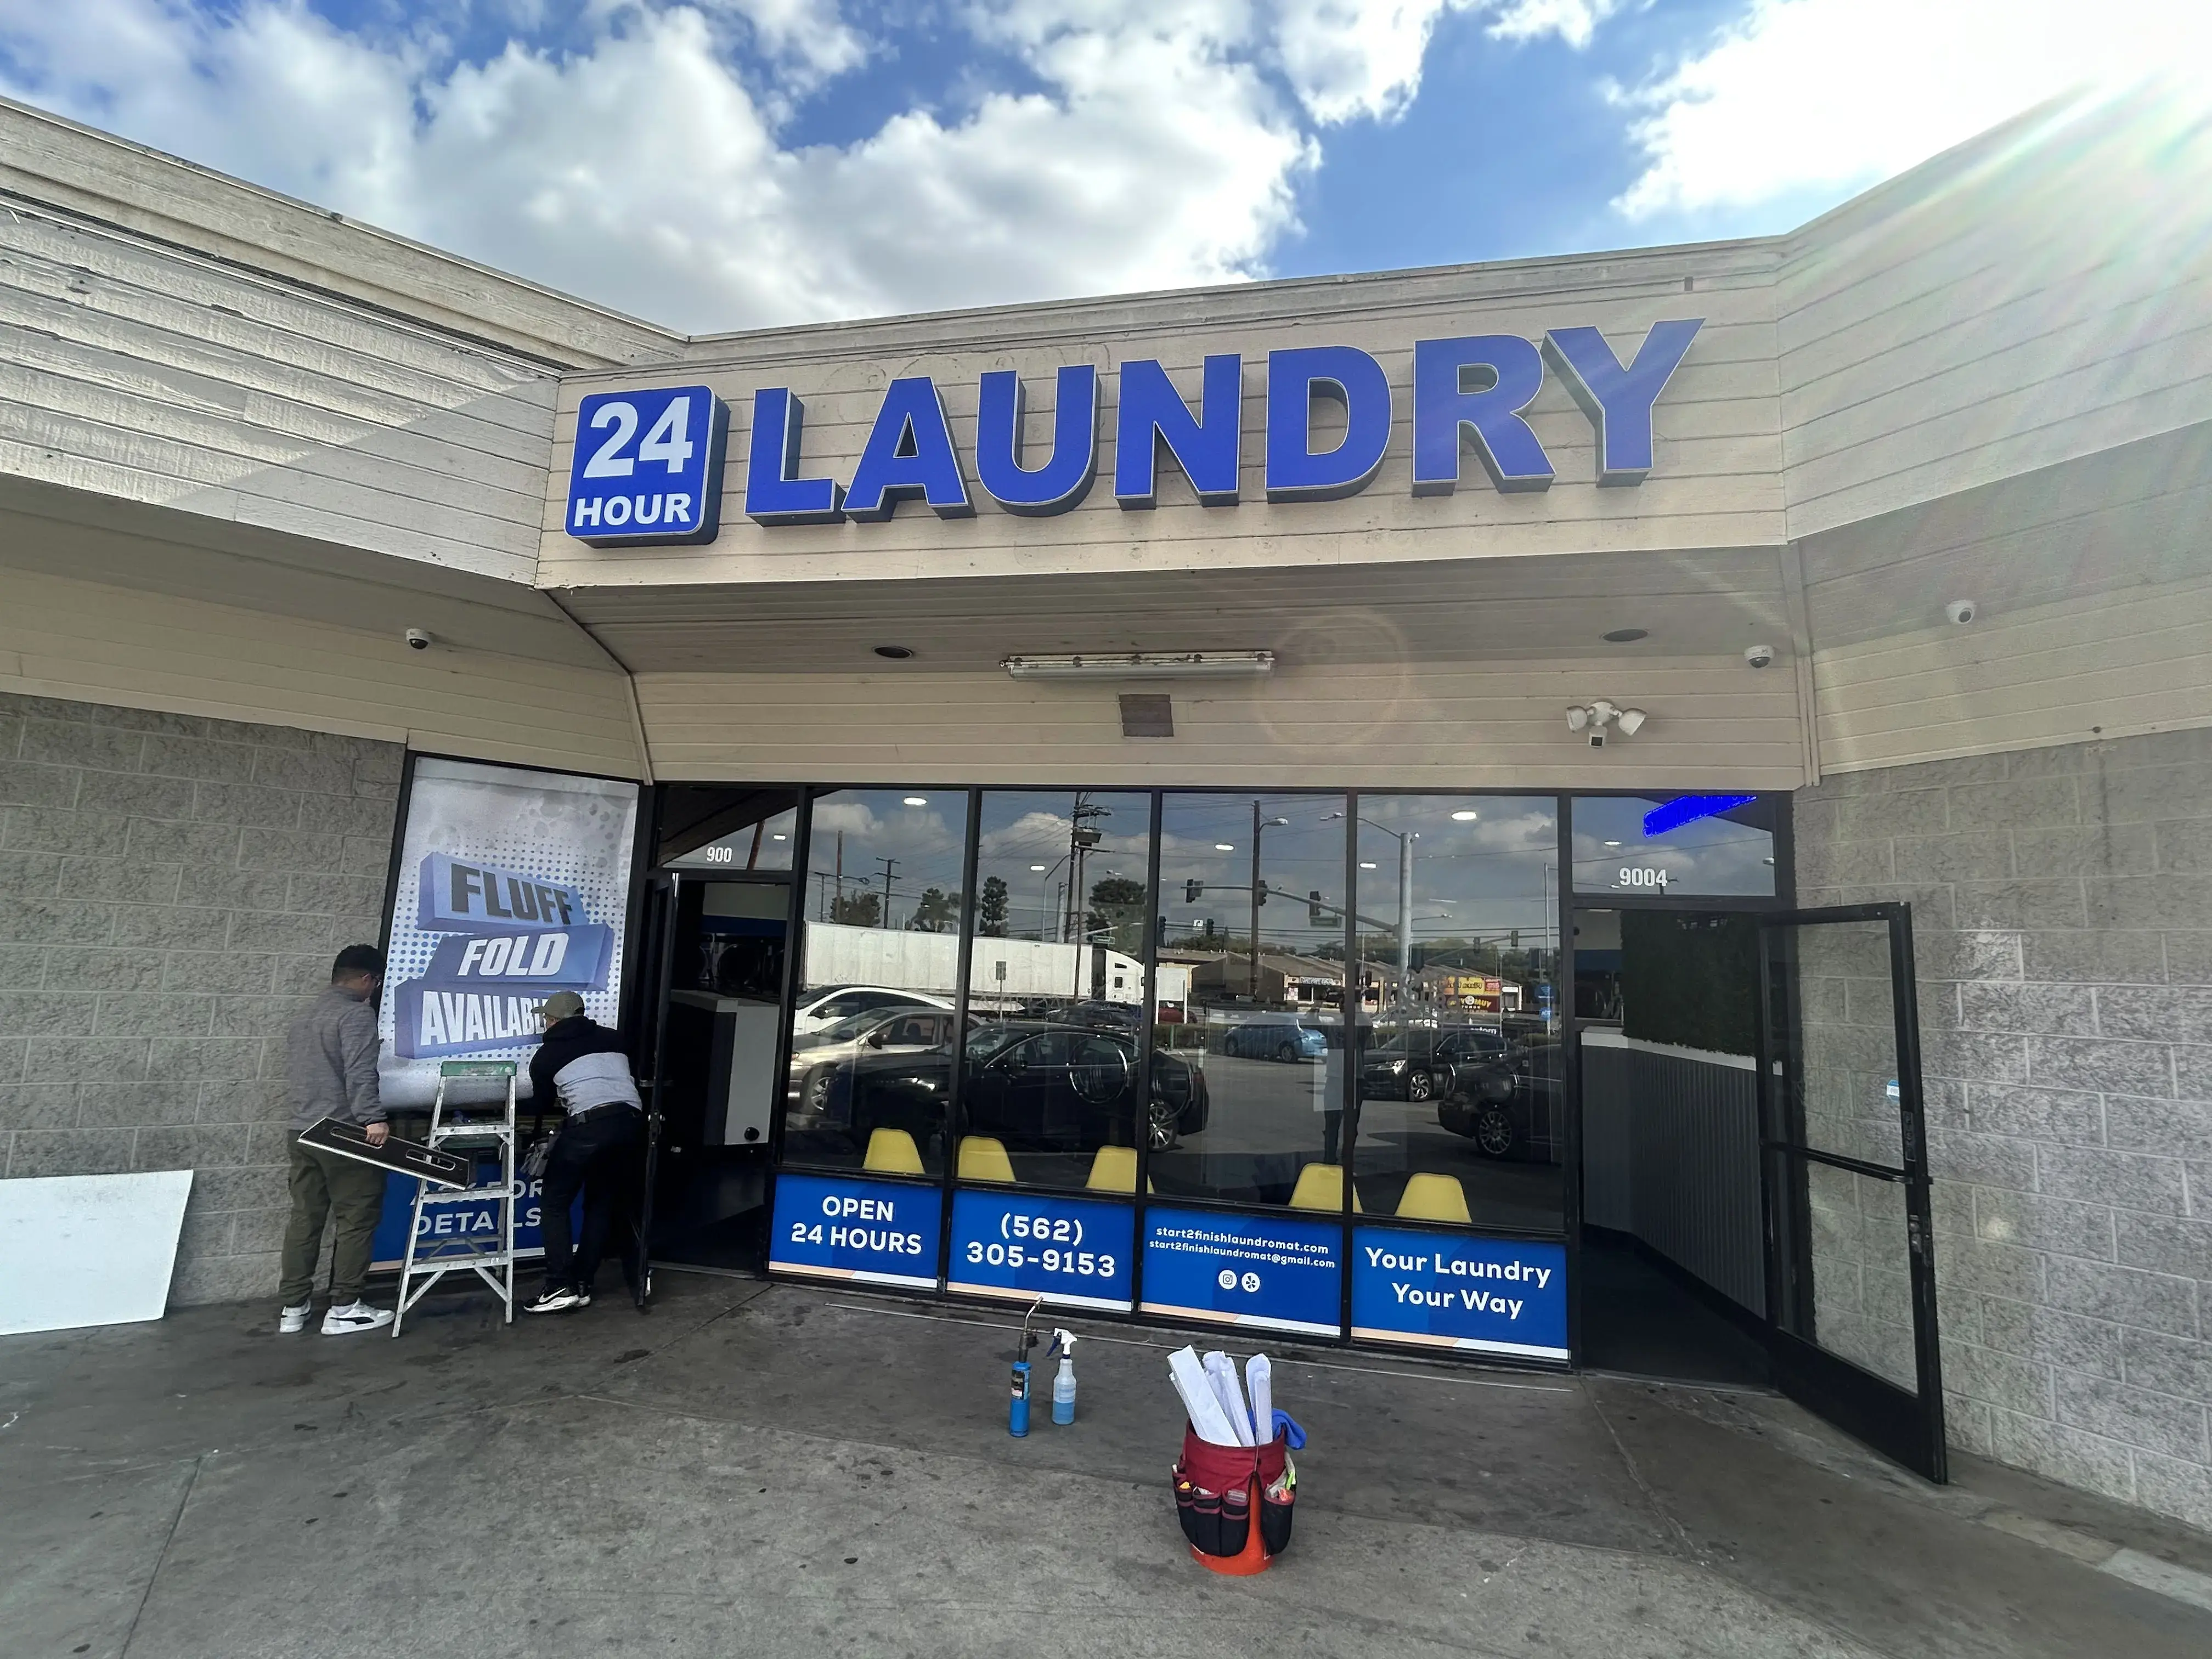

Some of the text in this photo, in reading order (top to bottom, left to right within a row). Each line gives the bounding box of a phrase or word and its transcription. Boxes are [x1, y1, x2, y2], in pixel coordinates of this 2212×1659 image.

[745, 318, 1706, 516] LAUNDRY
[583, 396, 693, 478] 24
[574, 492, 691, 527] HOUR
[707, 847, 733, 862] 900
[450, 863, 573, 925] FLUFF
[1619, 867, 1667, 887] 9004
[458, 933, 569, 977] FOLD
[417, 1207, 541, 1235] DETAS
[822, 1195, 894, 1221] OPEN
[791, 1222, 922, 1255] 24 HOURS
[1001, 1212, 1083, 1246] (562)
[1156, 1227, 1329, 1254] start2finishlaundromat.com
[967, 1241, 1115, 1278] 305-9153
[1149, 1239, 1335, 1268] start2finishlaundromat@gmail.com
[1364, 1246, 1551, 1288] Your Laundry
[1392, 1282, 1523, 1319] Your Way
